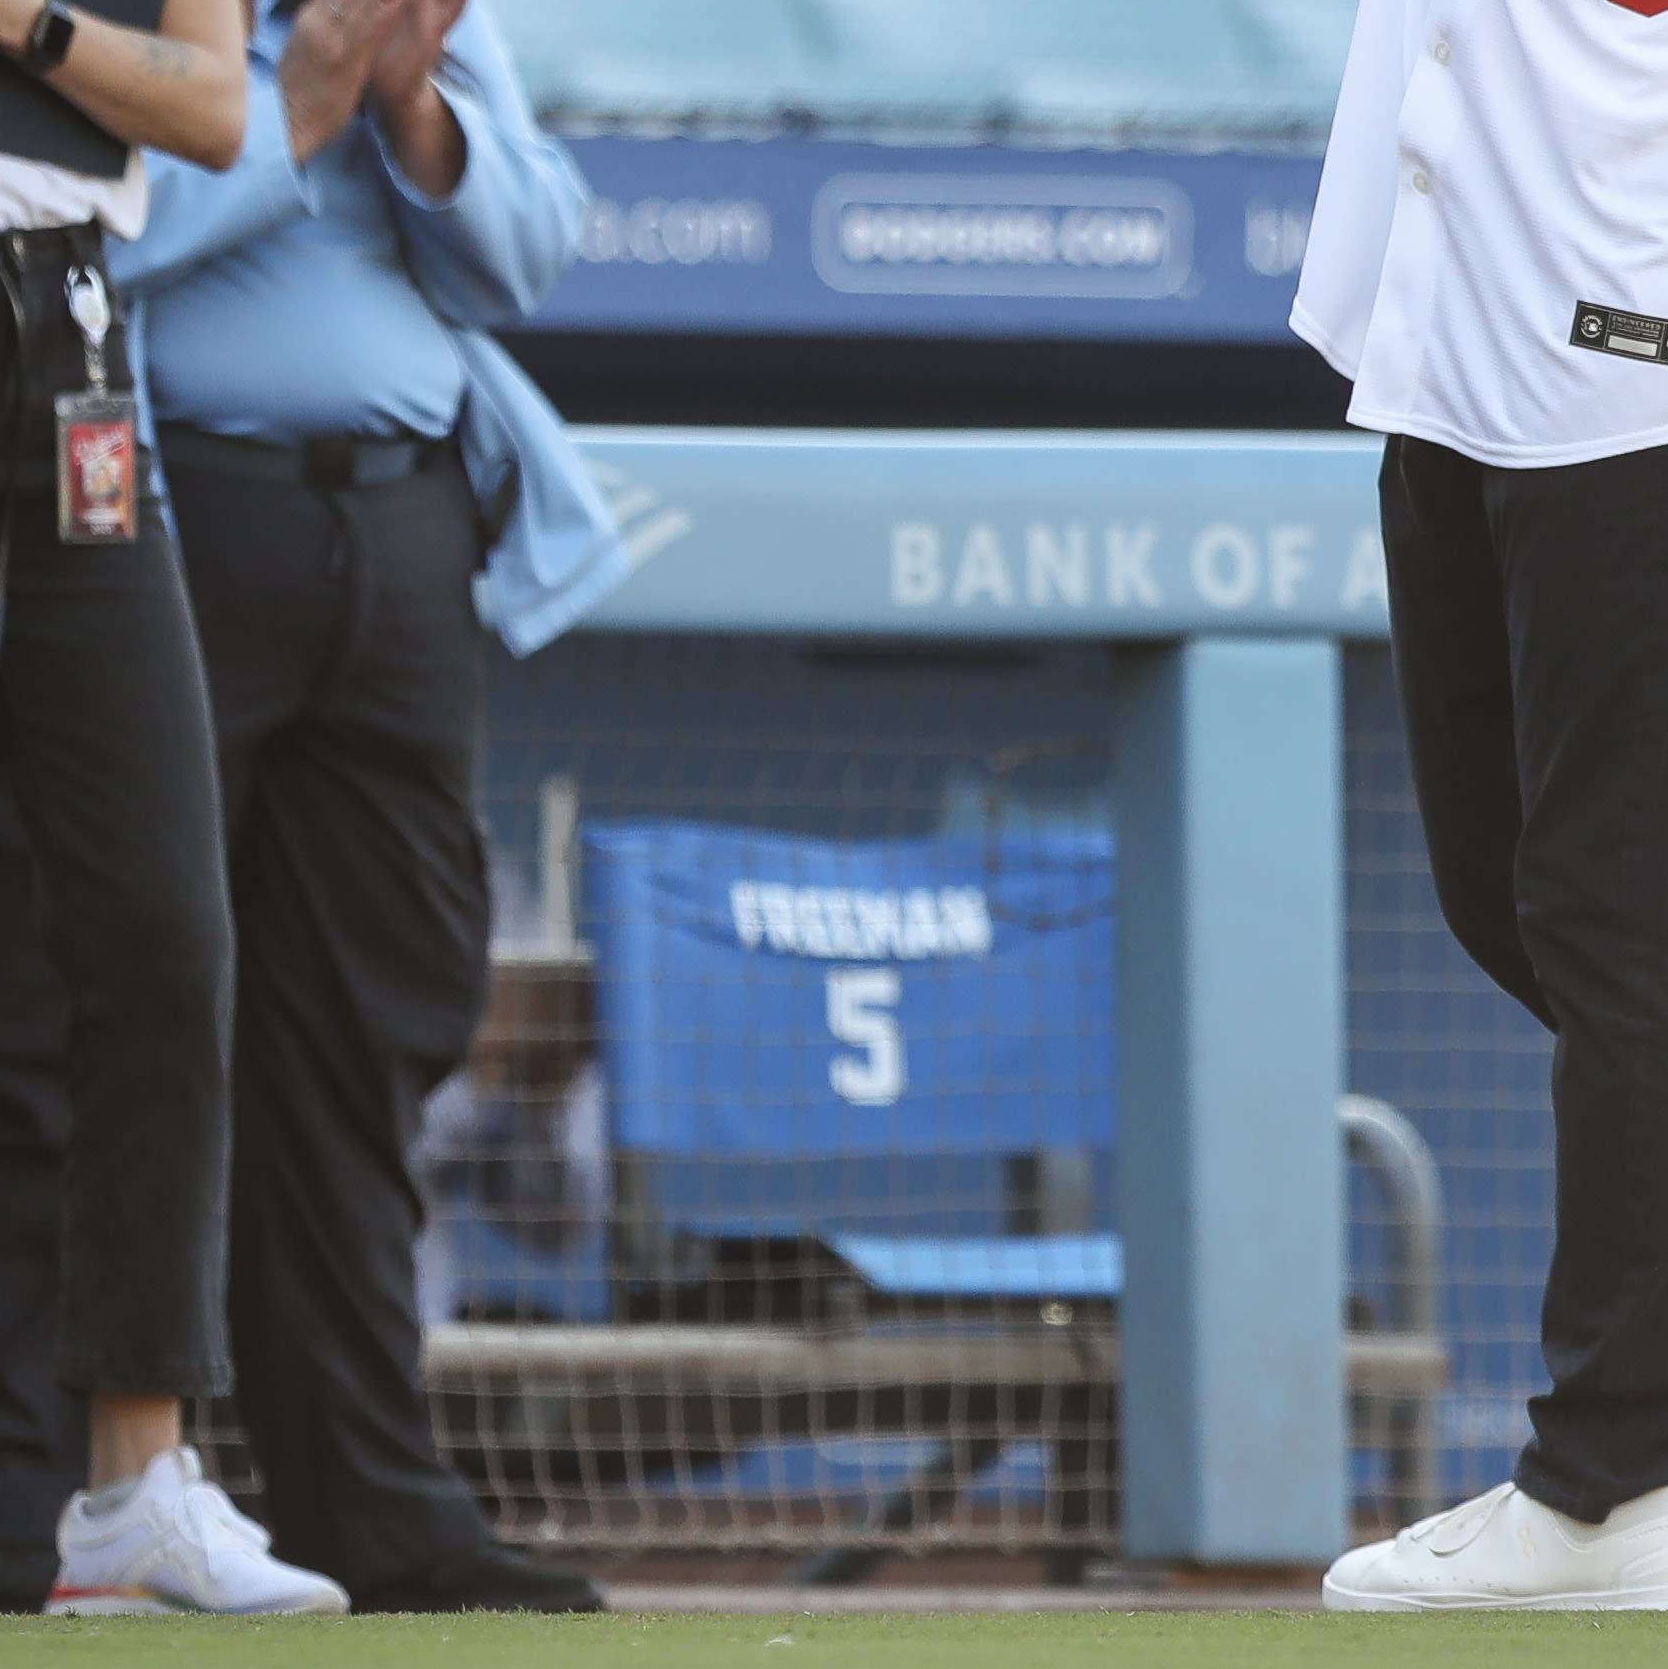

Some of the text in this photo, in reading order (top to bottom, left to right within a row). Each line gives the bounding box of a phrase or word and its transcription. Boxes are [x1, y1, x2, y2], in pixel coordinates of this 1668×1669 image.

[888, 522, 1165, 611] BANK
[1190, 522, 1316, 611] OF
[825, 964, 908, 1108] 5
